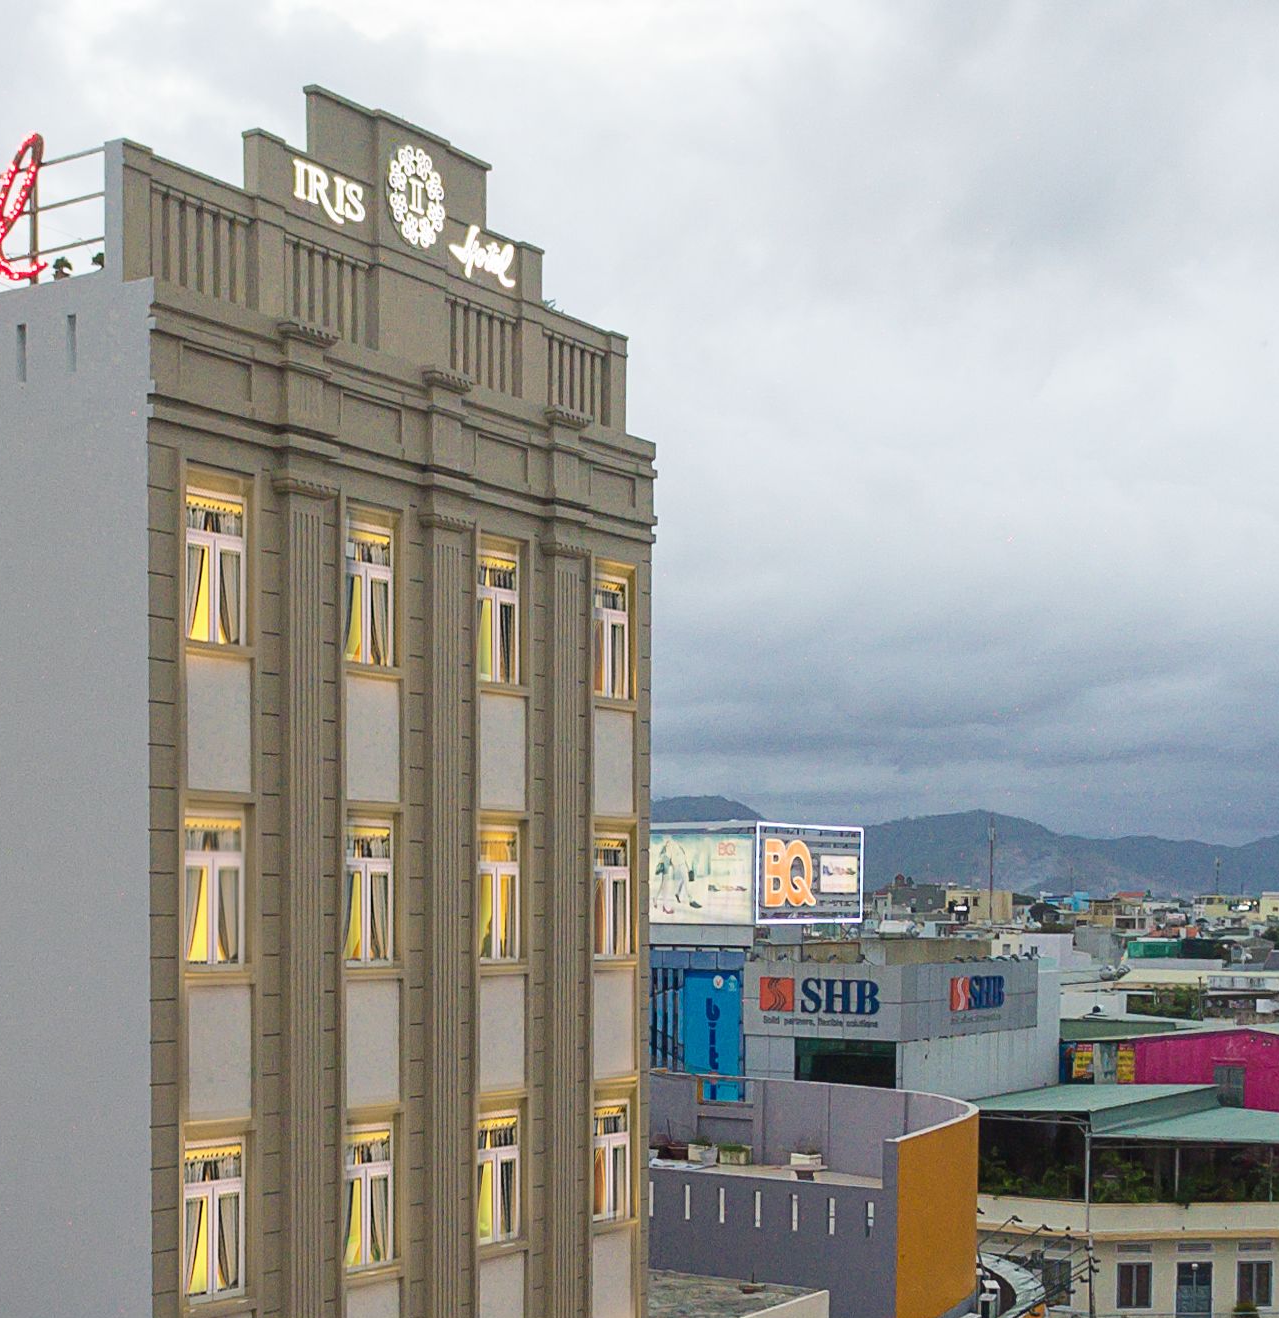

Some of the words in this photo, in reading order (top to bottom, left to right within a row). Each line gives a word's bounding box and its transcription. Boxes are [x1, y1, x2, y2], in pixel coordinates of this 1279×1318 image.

[292, 158, 366, 225] IRIS
[448, 225, 516, 288] Hotel
[717, 842, 737, 857] BQ
[764, 838, 817, 908] BQ
[801, 976, 881, 1016] SHB
[969, 975, 1005, 1010] SHB
